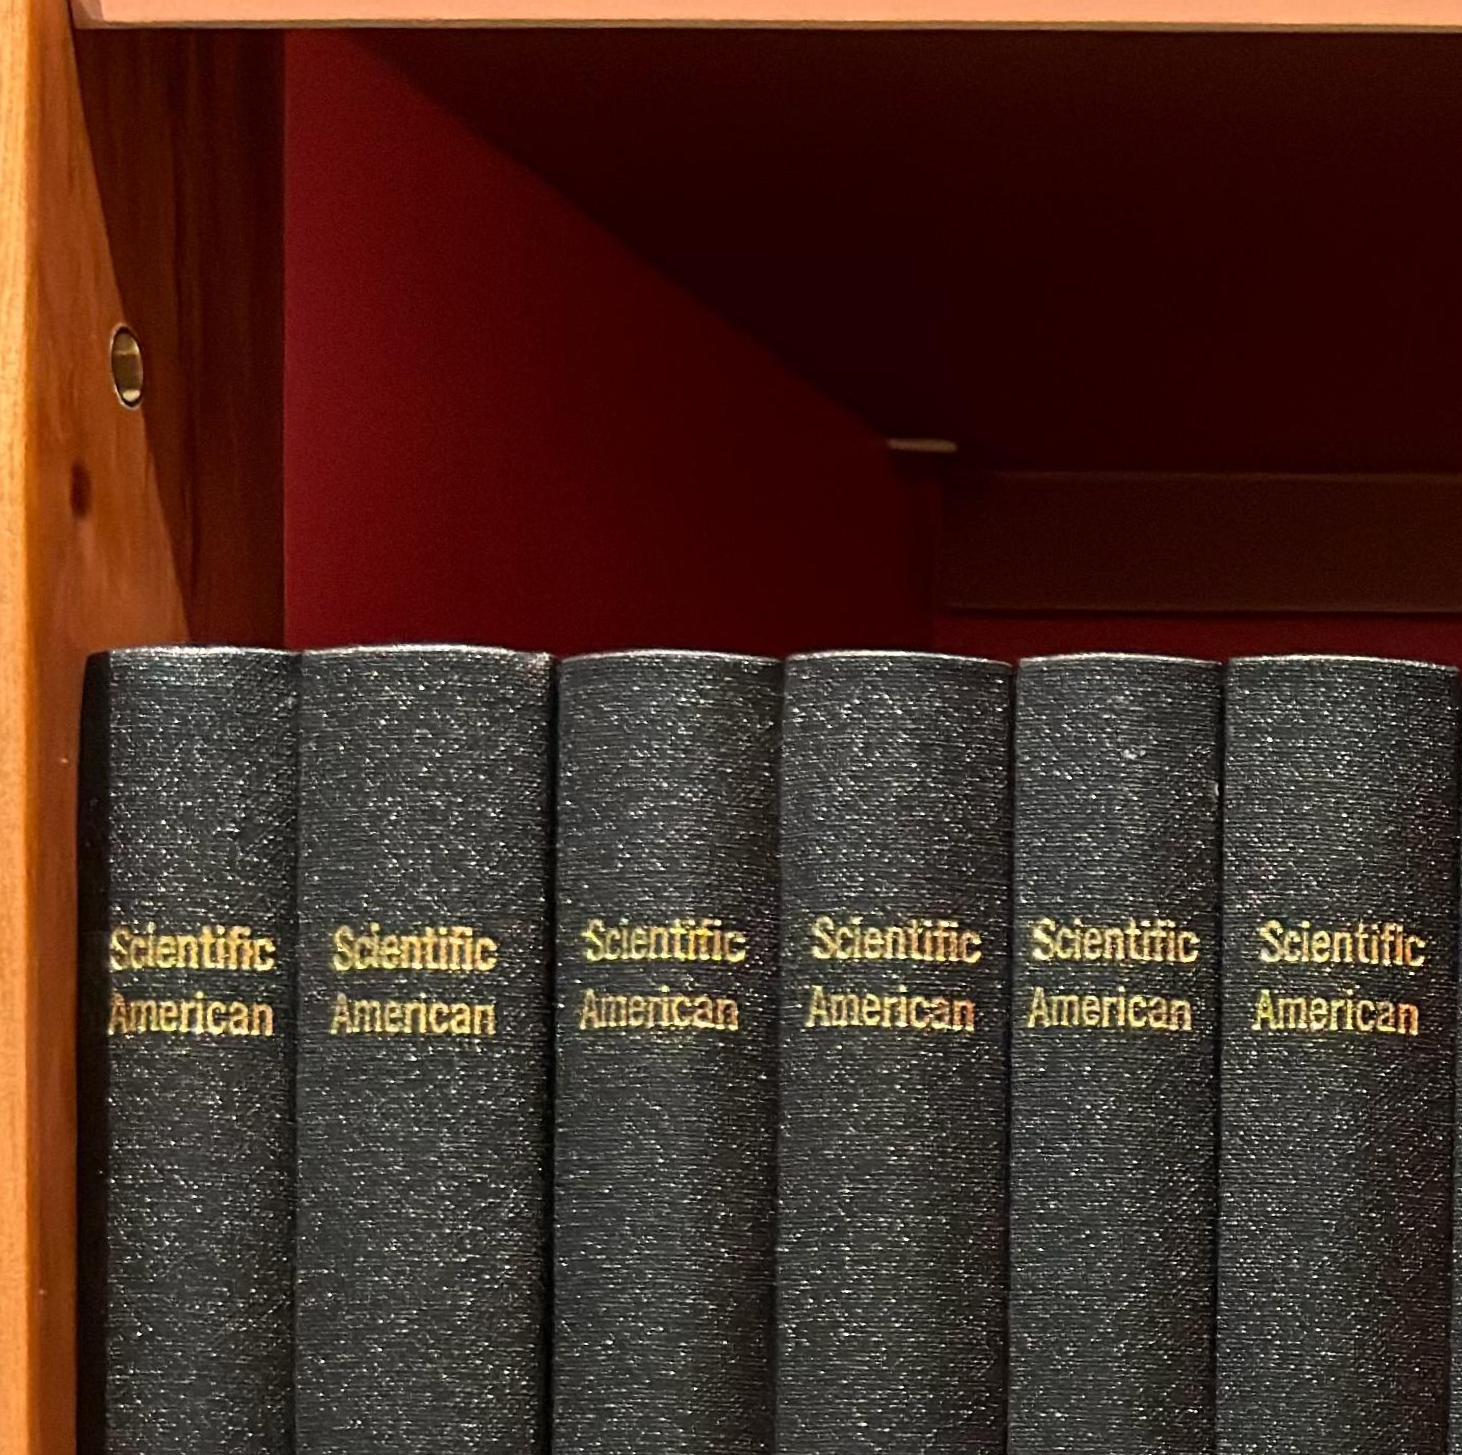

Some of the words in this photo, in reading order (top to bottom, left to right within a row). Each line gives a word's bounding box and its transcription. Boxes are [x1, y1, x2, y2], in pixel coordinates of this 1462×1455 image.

[111, 926, 276, 972] Scientific
[583, 918, 748, 964] Scientific
[1259, 921, 1427, 968] Scientific
[108, 992, 274, 1037] American
[580, 991, 739, 1032] American
[1255, 991, 1420, 1036] American
